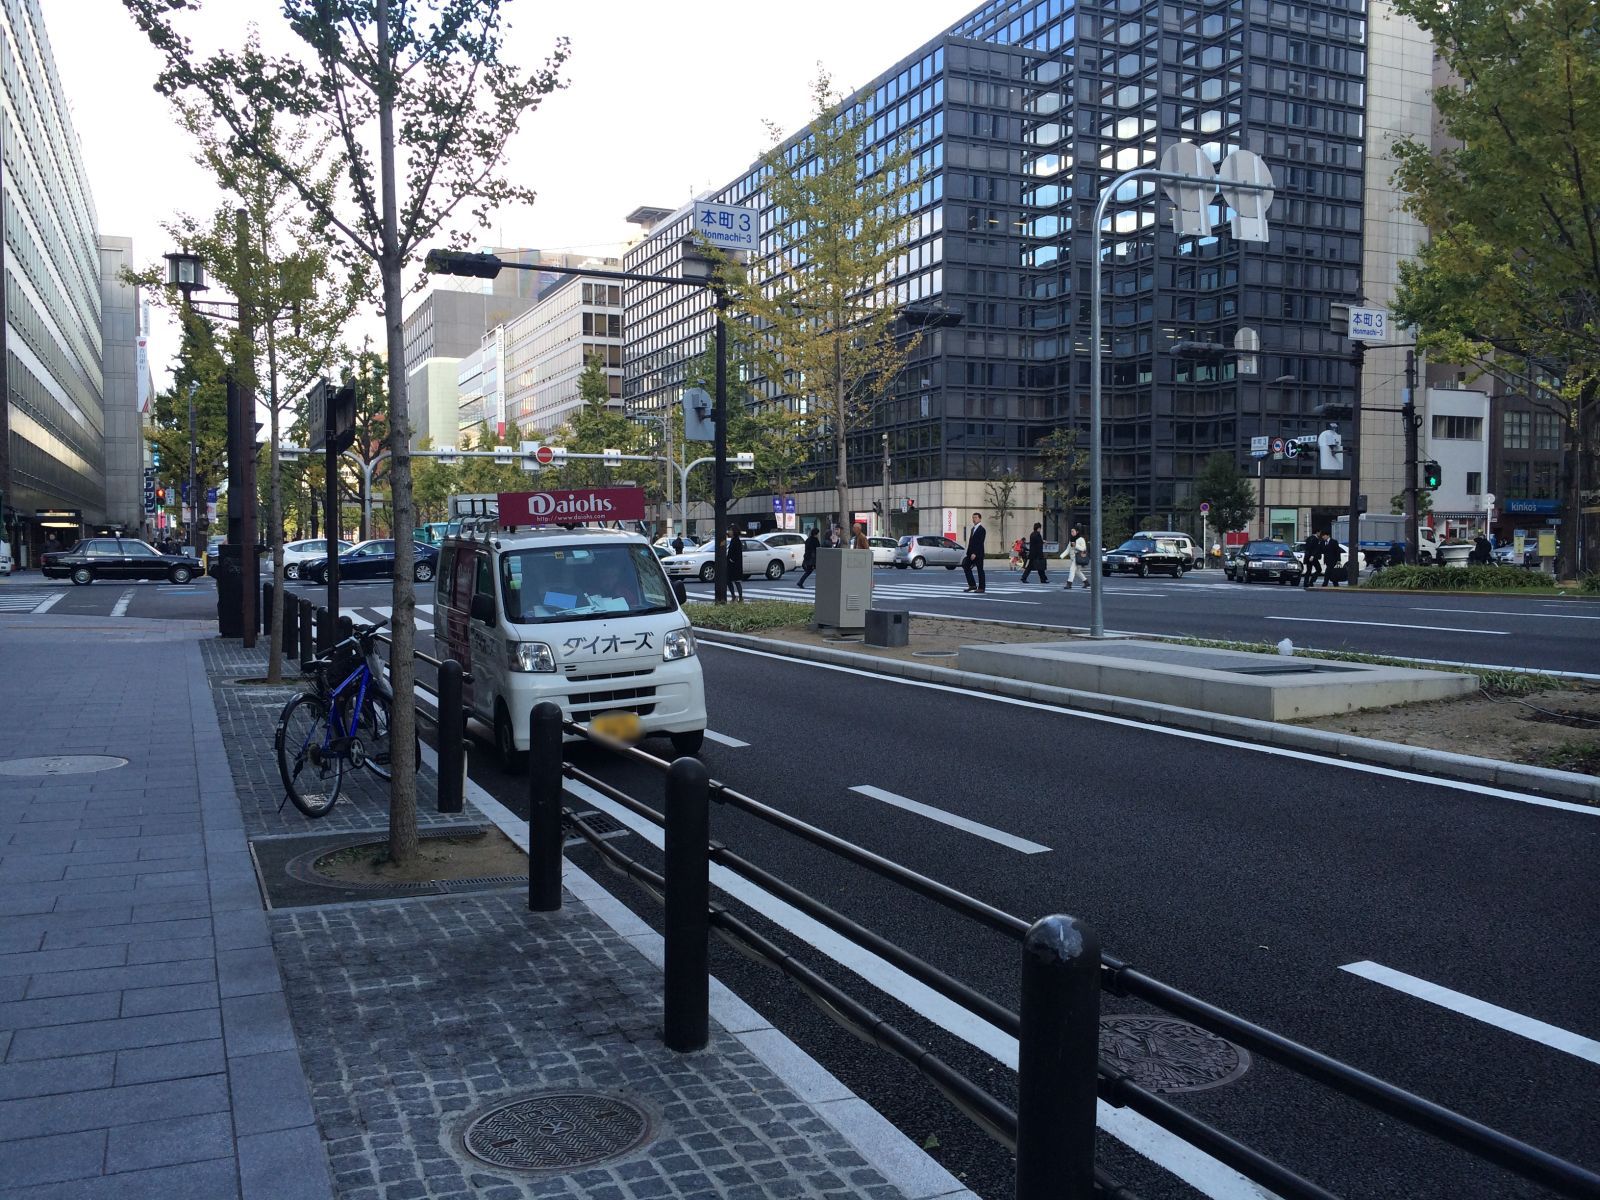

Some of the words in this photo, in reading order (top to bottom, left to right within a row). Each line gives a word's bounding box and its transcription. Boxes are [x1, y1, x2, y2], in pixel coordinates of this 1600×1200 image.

[700, 208, 751, 232] 本町3
[701, 228, 752, 244] Honmachi-3
[1352, 312, 1383, 328] 本町3
[527, 492, 613, 516] Daiohs
[536, 513, 606, 522] http://www.daiohs.com
[563, 631, 655, 657] ダイオーズ
